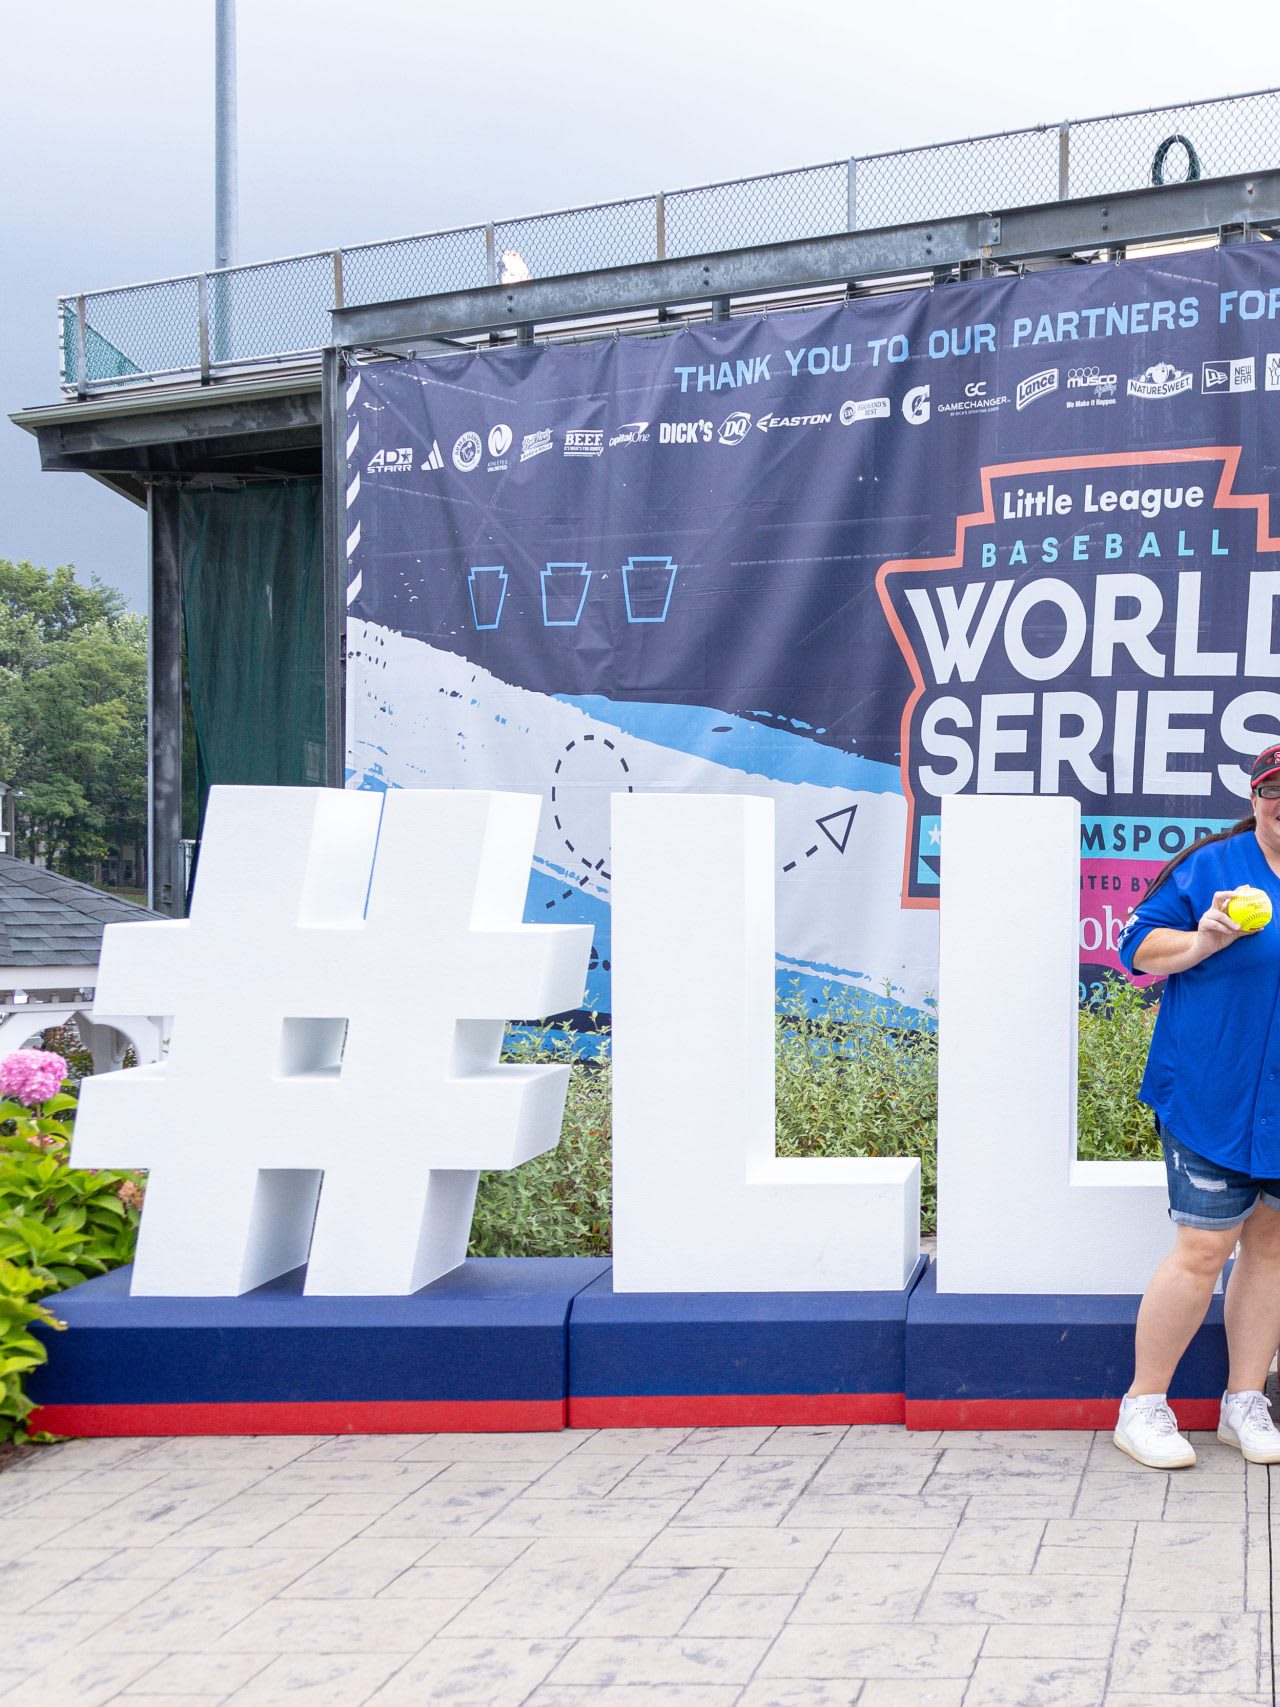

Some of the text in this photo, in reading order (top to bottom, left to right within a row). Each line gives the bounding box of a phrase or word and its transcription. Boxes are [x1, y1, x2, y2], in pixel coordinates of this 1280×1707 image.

[674, 354, 771, 393] THANK
[785, 344, 851, 377] YOU
[868, 335, 909, 366] TO
[929, 323, 996, 359] OUR
[1013, 297, 1199, 347] PARTNERS
[1235, 365, 1251, 376] NEW
[1235, 375, 1251, 385] ERA
[965, 381, 986, 397] GC
[1019, 374, 1055, 398] Lance
[724, 418, 747, 437] DQ
[769, 412, 832, 427] EASTON
[659, 419, 713, 443] DICK'S
[367, 465, 412, 473] STARR
[1003, 484, 1204, 519] Little League
[982, 529, 1229, 568] BASEBALL
